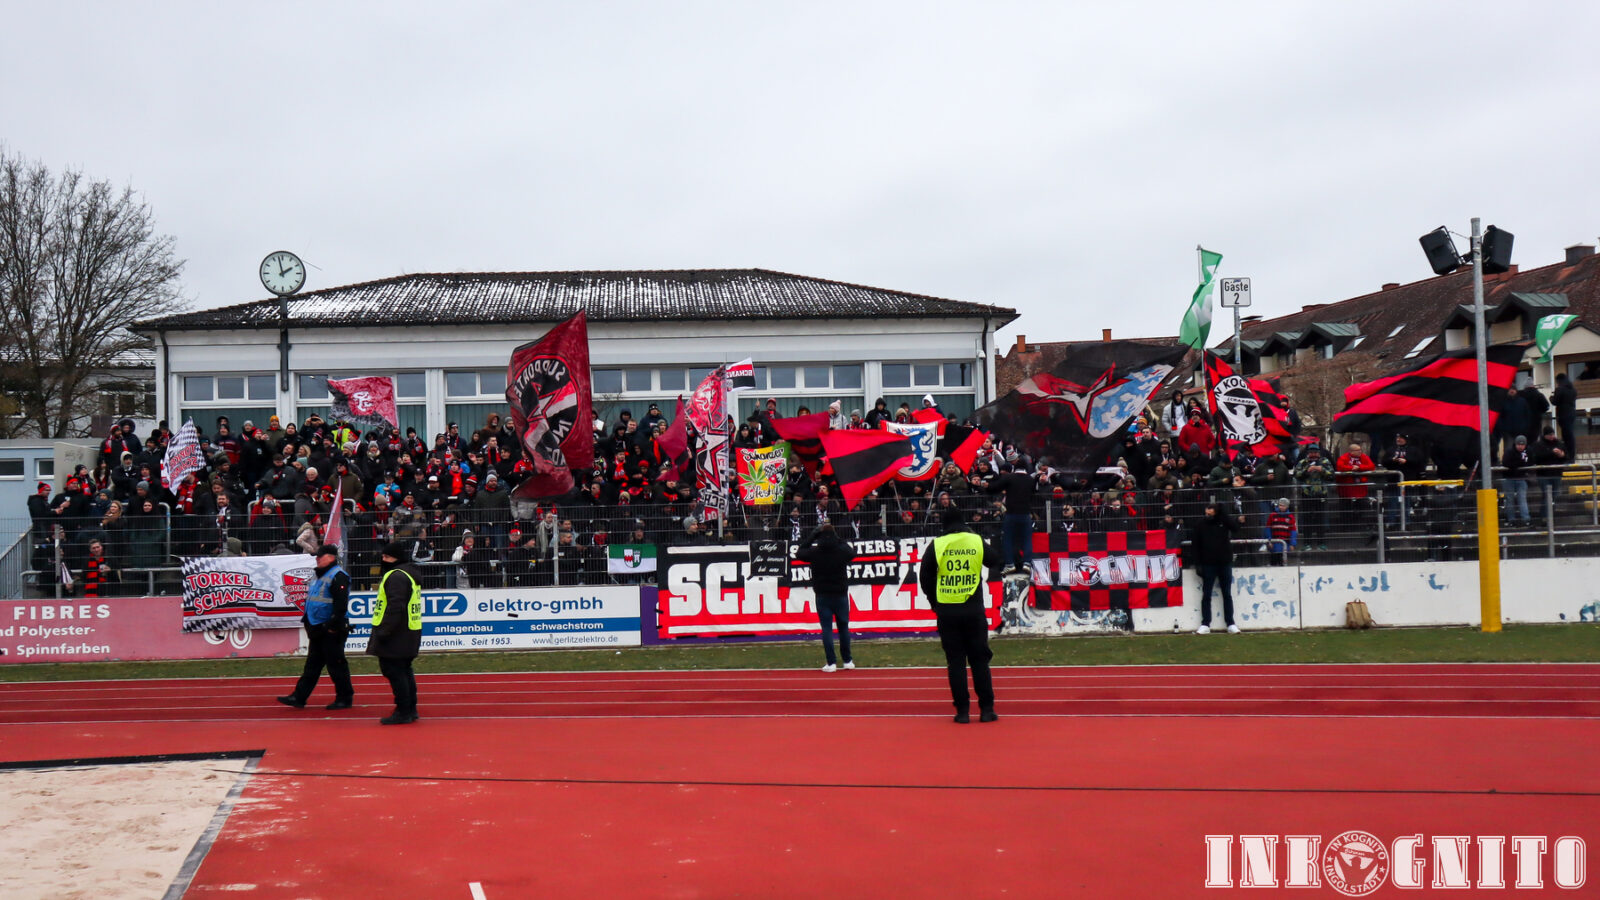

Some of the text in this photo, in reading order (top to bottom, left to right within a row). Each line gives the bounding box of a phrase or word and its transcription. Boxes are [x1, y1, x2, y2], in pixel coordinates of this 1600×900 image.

[1224, 281, 1249, 291] Gäste
[1233, 292, 1240, 305] 2
[946, 559, 970, 572] 034
[186, 572, 252, 591] TORKEL
[940, 573, 977, 586] EMPIRE
[193, 589, 273, 615] SCHANZER
[478, 597, 604, 614] elektro-gmbh
[14, 604, 111, 620] FIBRES
[19, 625, 96, 639] Polyester-
[434, 623, 494, 634] anlagenbau
[530, 621, 604, 631] schwachstrom
[471, 637, 489, 646] Seit
[490, 637, 513, 646] 1953.
[16, 642, 111, 658] Spinnfarben
